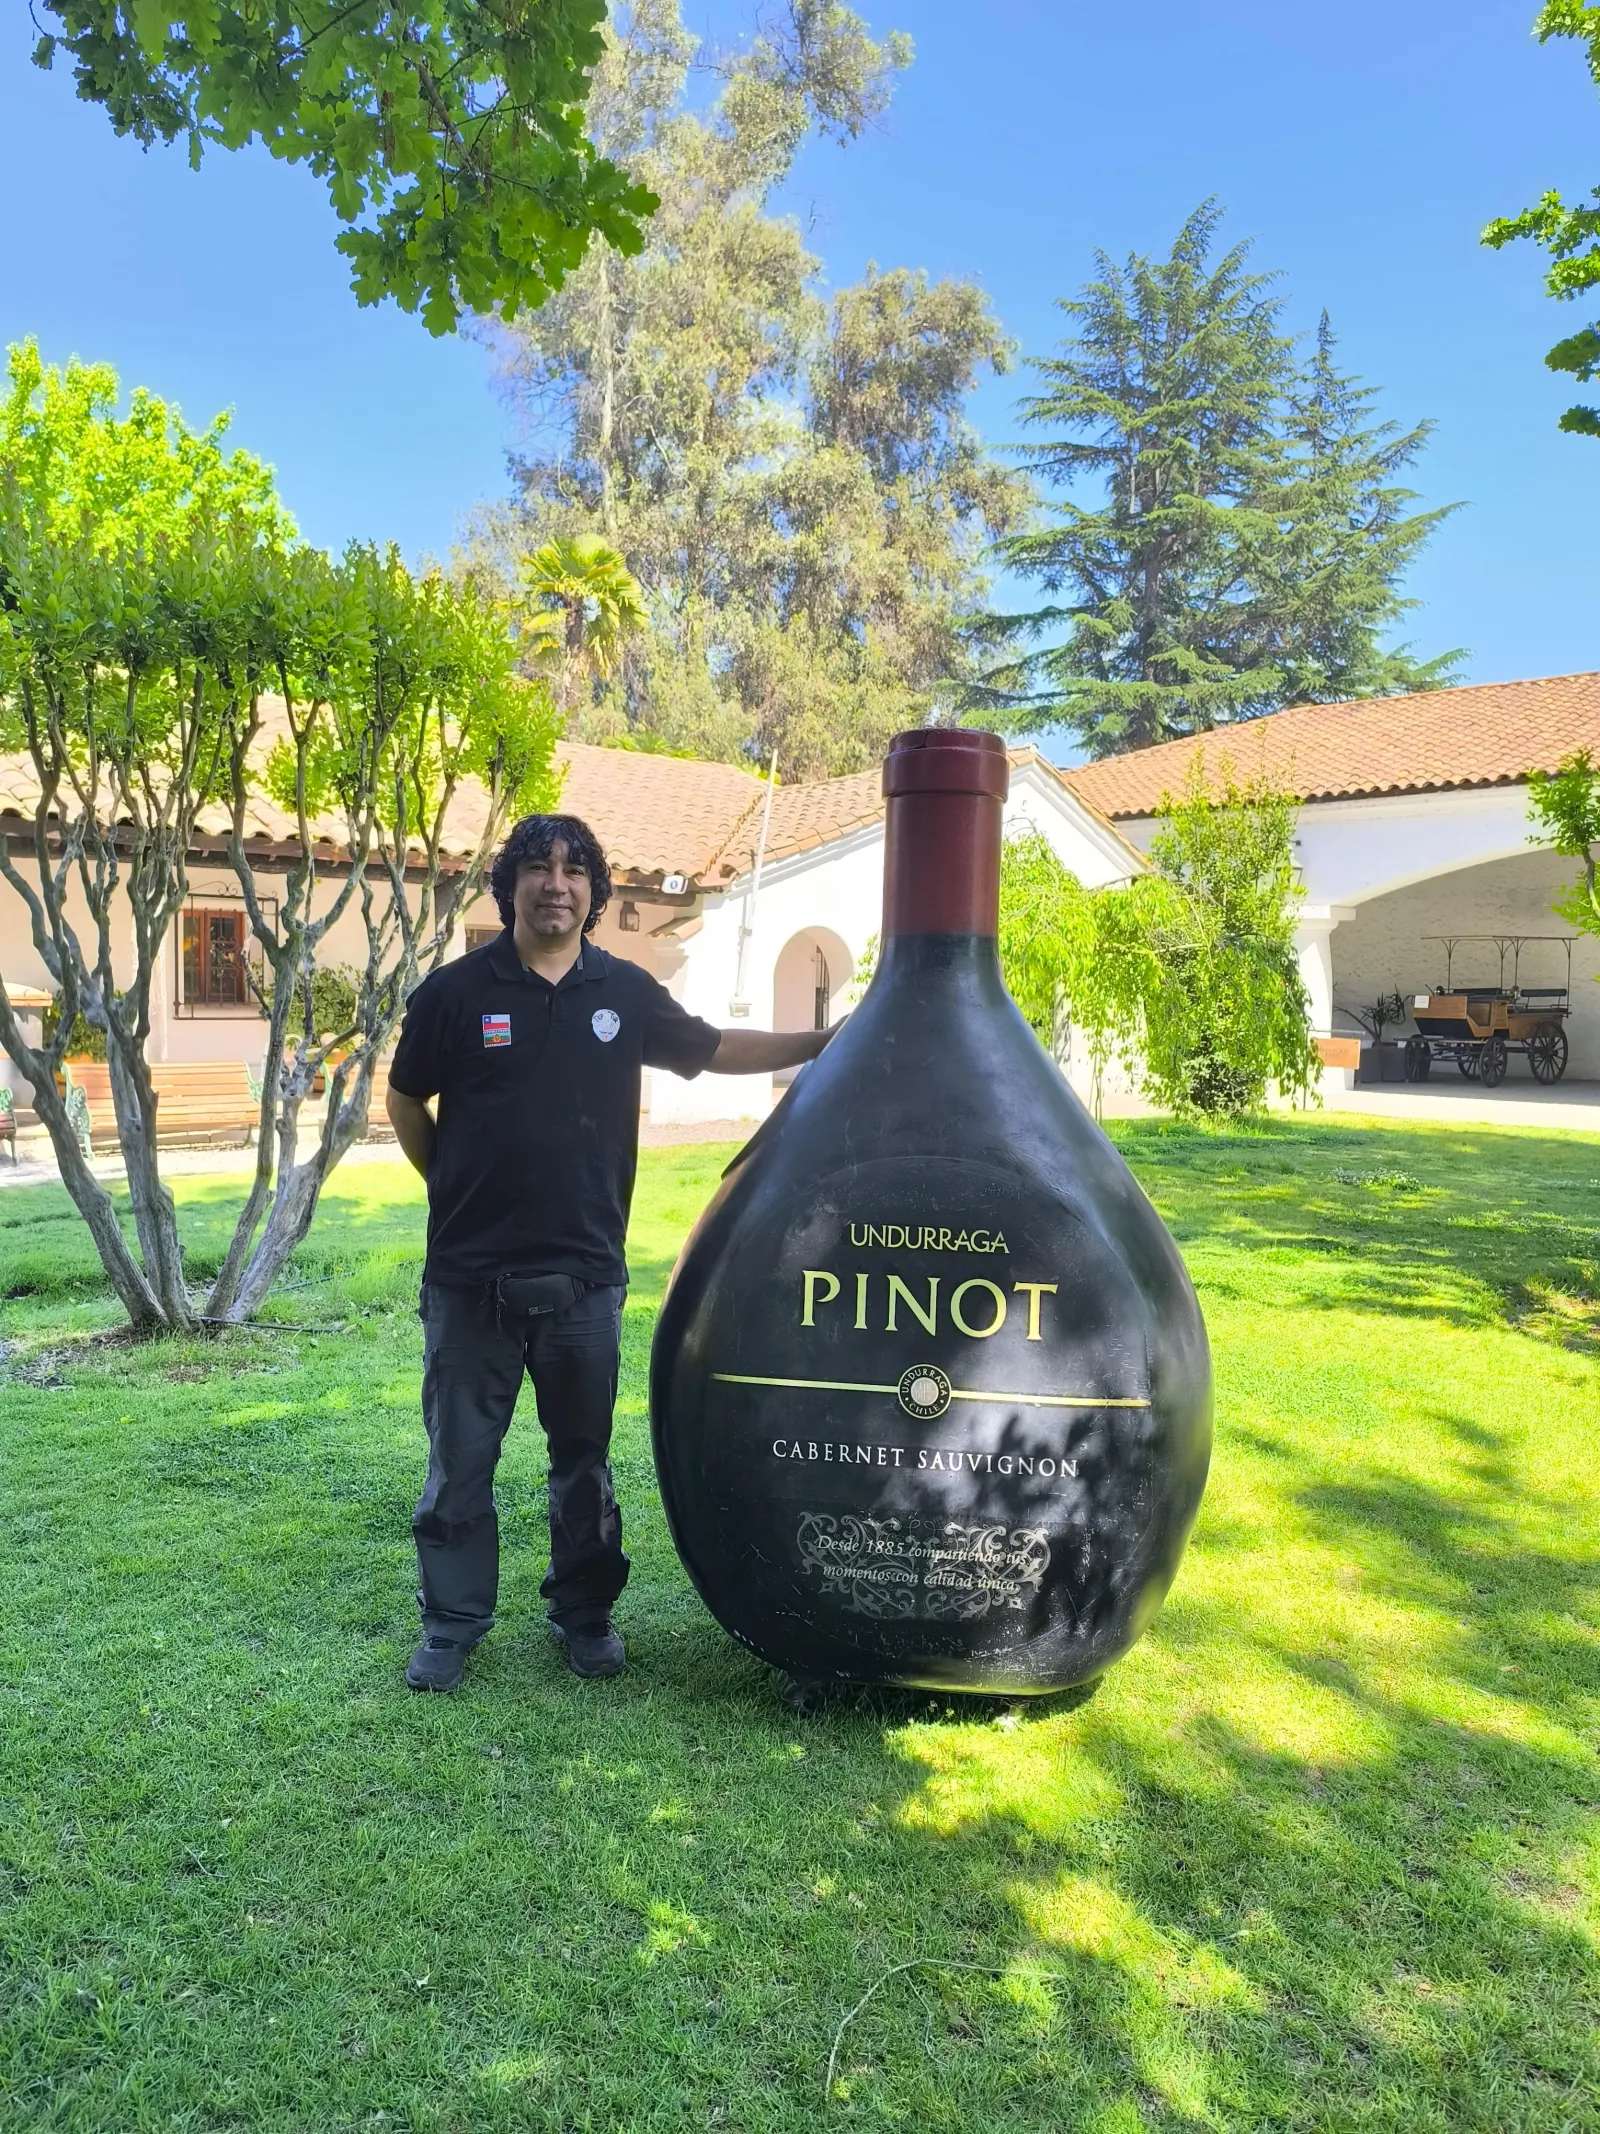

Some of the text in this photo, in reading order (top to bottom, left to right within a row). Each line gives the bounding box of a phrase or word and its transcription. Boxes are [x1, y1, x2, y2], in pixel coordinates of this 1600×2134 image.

[850, 1223, 1010, 1254] UNDURRAGA
[800, 1269, 1059, 1341] PINOT
[901, 1368, 948, 1397] UNDURRAGA
[909, 1403, 941, 1415] CHILE
[772, 1439, 1079, 1478] CABERNET SAUVIGNON
[816, 1535, 1028, 1564] Desde 1885 compartiendo tus
[822, 1565, 891, 1580] momentos
[895, 1572, 919, 1584] con
[923, 1571, 973, 1588] calidad
